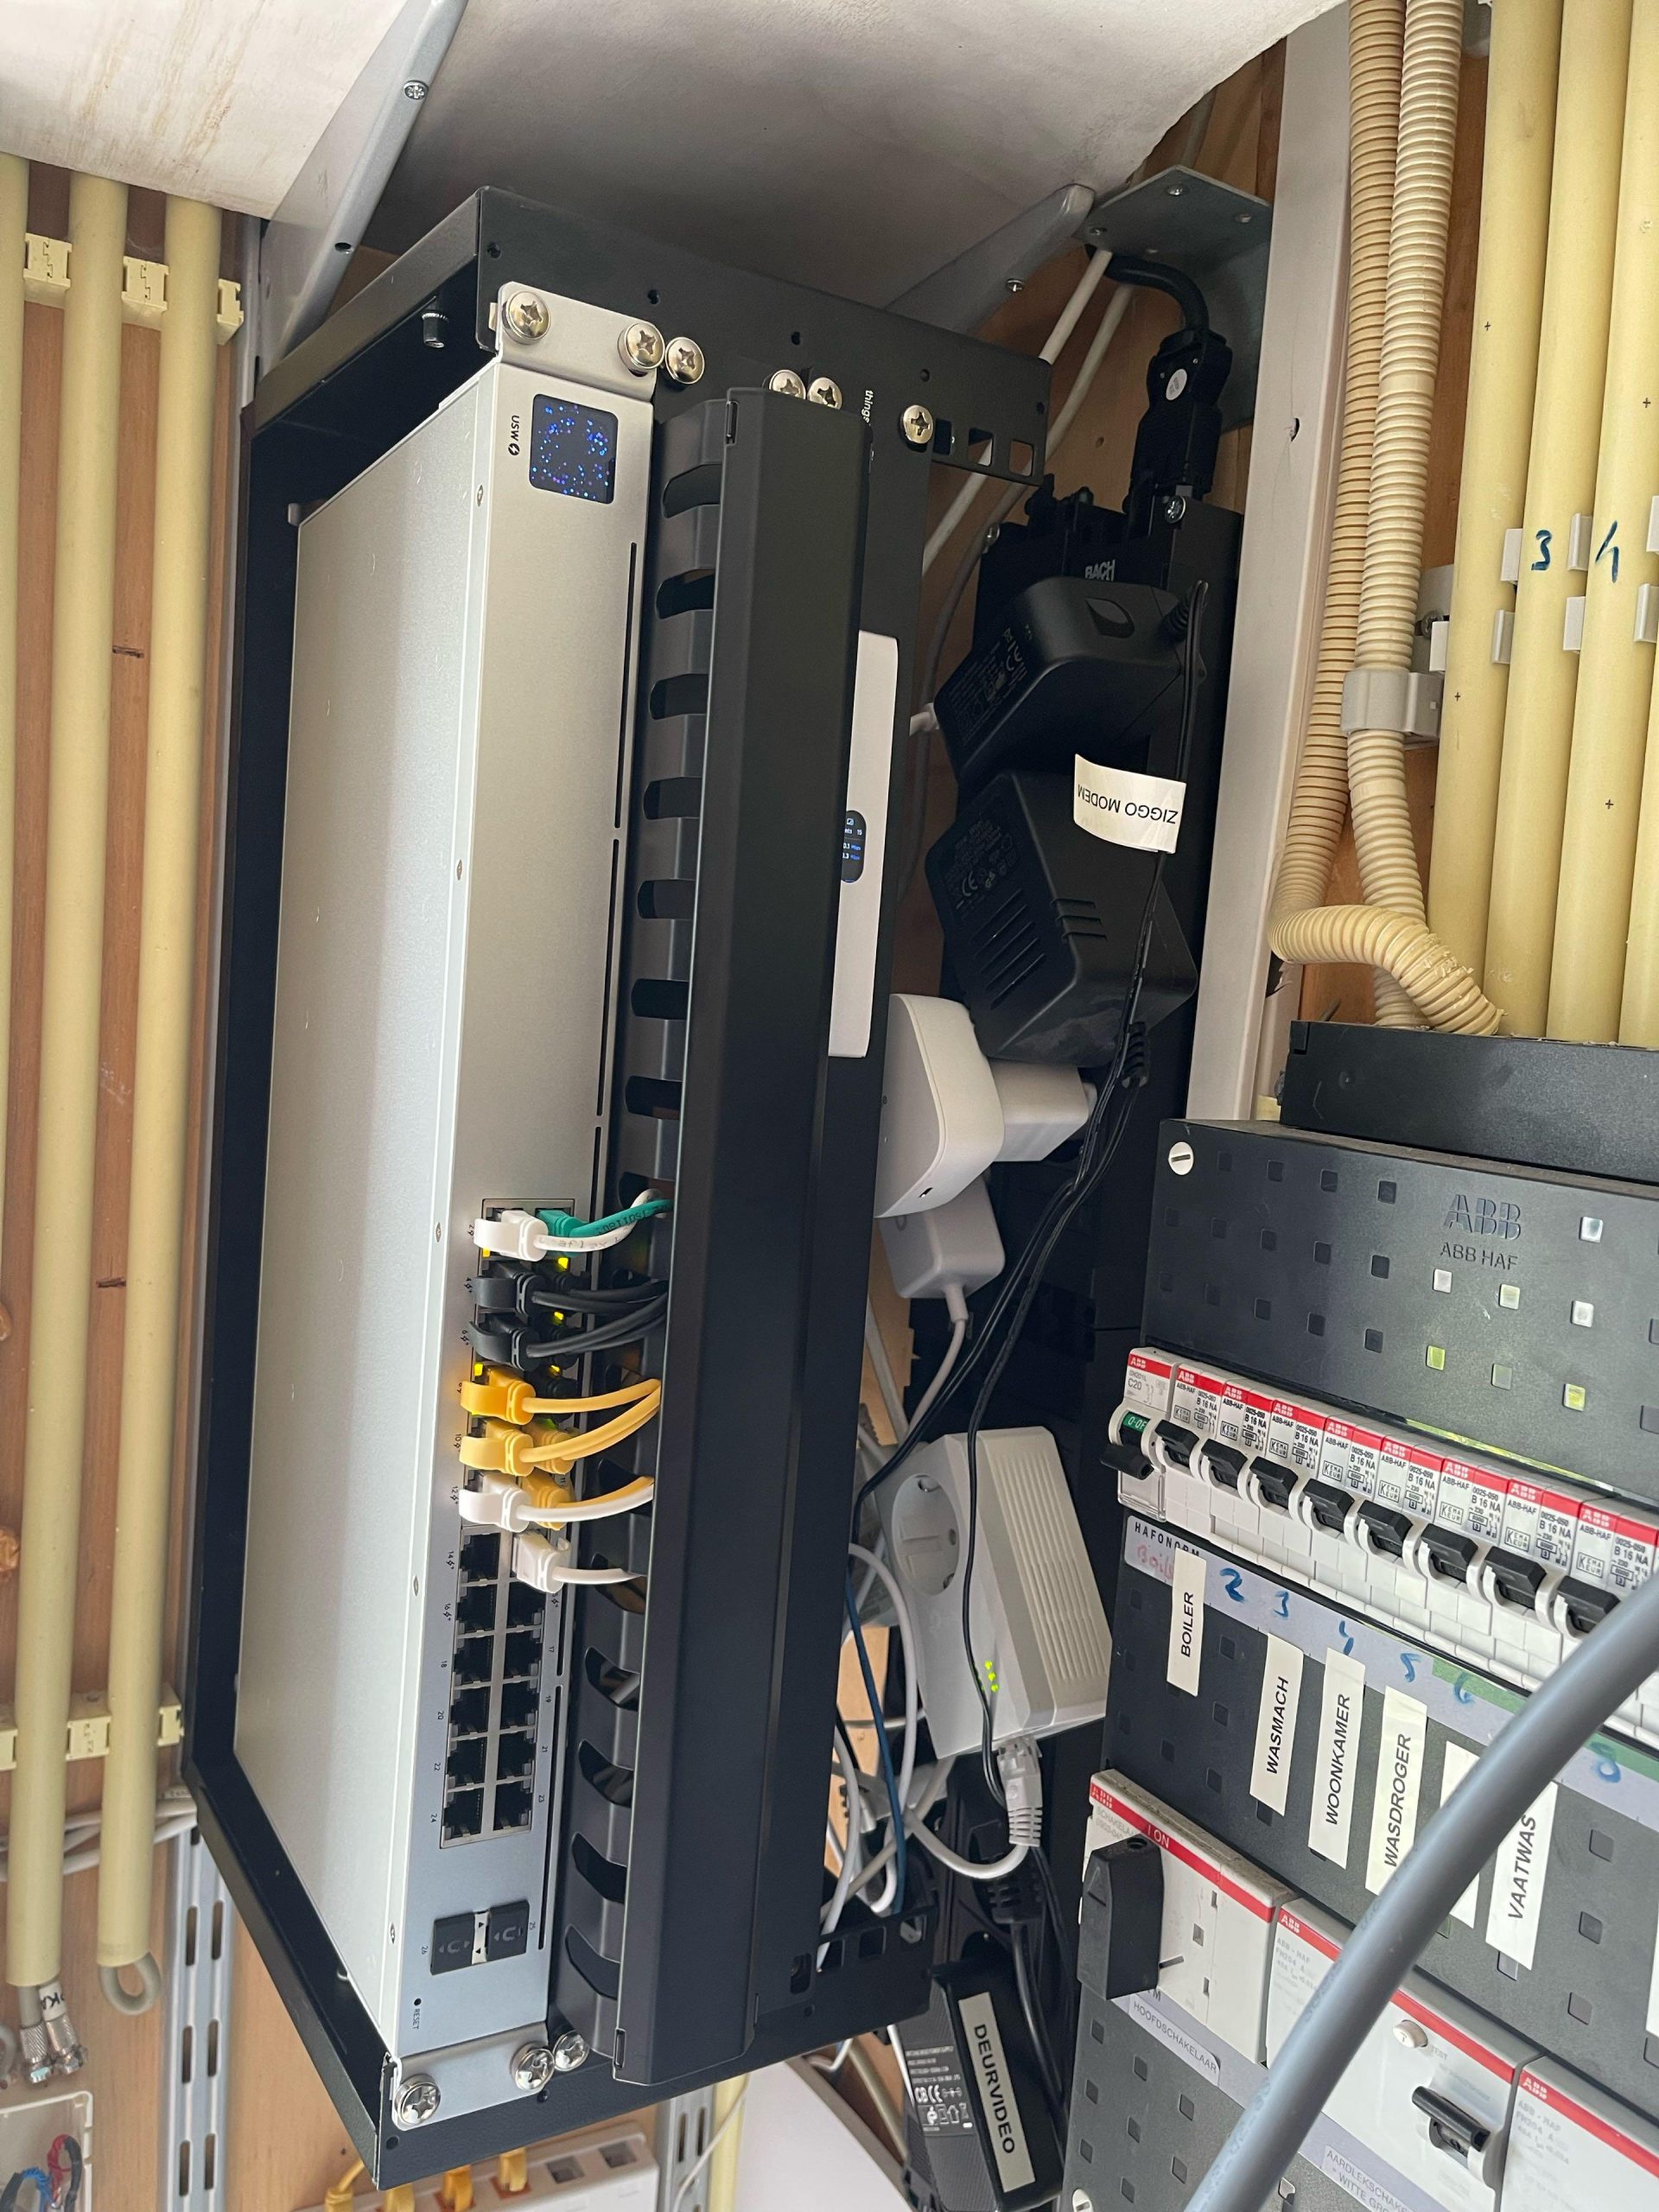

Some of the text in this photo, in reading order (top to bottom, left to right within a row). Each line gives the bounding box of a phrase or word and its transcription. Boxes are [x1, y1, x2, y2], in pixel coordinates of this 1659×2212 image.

[510, 415, 520, 442] USW
[1530, 529, 1554, 571] 3
[1595, 520, 1620, 583] 4
[1077, 784, 1179, 825] ZIGGO MODEM
[1444, 1194, 1522, 1241] ABB
[1440, 1242, 1518, 1270] ABB HAF
[1130, 1357, 1147, 1370] ABB
[1128, 1377, 1142, 1390] C20
[1178, 1370, 1195, 1384] ABB
[1224, 1385, 1243, 1401] ABB
[1197, 1396, 1217, 1413] B 16 NA
[1223, 1397, 1244, 1410] ABB-HAF
[1273, 1402, 1294, 1417] ABB
[1244, 1413, 1267, 1429] B 16 NA
[1272, 1414, 1294, 1427] ABB-HAF
[1326, 1421, 1348, 1437] ABB
[1294, 1431, 1319, 1447] B 16 NA
[1325, 1436, 1349, 1450] ABB-HAF
[1384, 1440, 1406, 1458] ABB
[1350, 1453, 1376, 1470] B 16 NA
[1381, 1454, 1407, 1468] ABB-HAF
[1445, 1461, 1469, 1478] ABB
[451, 1485, 459, 1494] 12
[1408, 1473, 1435, 1490] B 16 NA
[1442, 1476, 1470, 1491] ABB-HAF
[1510, 1483, 1536, 1501] ABB
[1471, 1494, 1501, 1513] B 16 NA
[1507, 1499, 1537, 1515] ABB-HAF
[1582, 1509, 1610, 1528] ABB
[1539, 1519, 1572, 1540] B 16 NA
[1580, 1523, 1611, 1541] ABB-HAF
[448, 1550, 454, 1559] 14
[1613, 1546, 1649, 1567] B 16 NA
[1219, 1567, 1245, 1603] 2
[1273, 1590, 1290, 1619] 3
[1180, 1592, 1194, 1657] BOILER
[1400, 1652, 1422, 1682] 5
[437, 1711, 444, 1720] 20
[1265, 1676, 1289, 1775] WASMACH
[434, 1762, 441, 1771] 22
[1325, 1694, 1351, 1826] WOONKAMER
[538, 1794, 545, 1803] 23
[1091, 1786, 1113, 1809] ABB
[1384, 1732, 1413, 1868] WASDROGER
[430, 1813, 437, 1823] 24
[1154, 1829, 1170, 1849] ON
[1508, 1814, 1536, 1919] VAATWAS
[529, 1921, 536, 1930] 25
[1281, 1914, 1300, 1934] ABB
[421, 1946, 429, 1955] 26
[1133, 2000, 1217, 2074] HOOFDSCHAKELAAR
[1431, 2045, 1448, 2061] TEST
[974, 2024, 1015, 2154] DEURVIDEO
[1522, 2076, 1548, 2100] ABB
[1326, 2150, 1408, 2212] AARDLEKSCHAKE
[1339, 2171, 1367, 2201] WITTE
[1369, 2197, 1389, 2212] GRO
